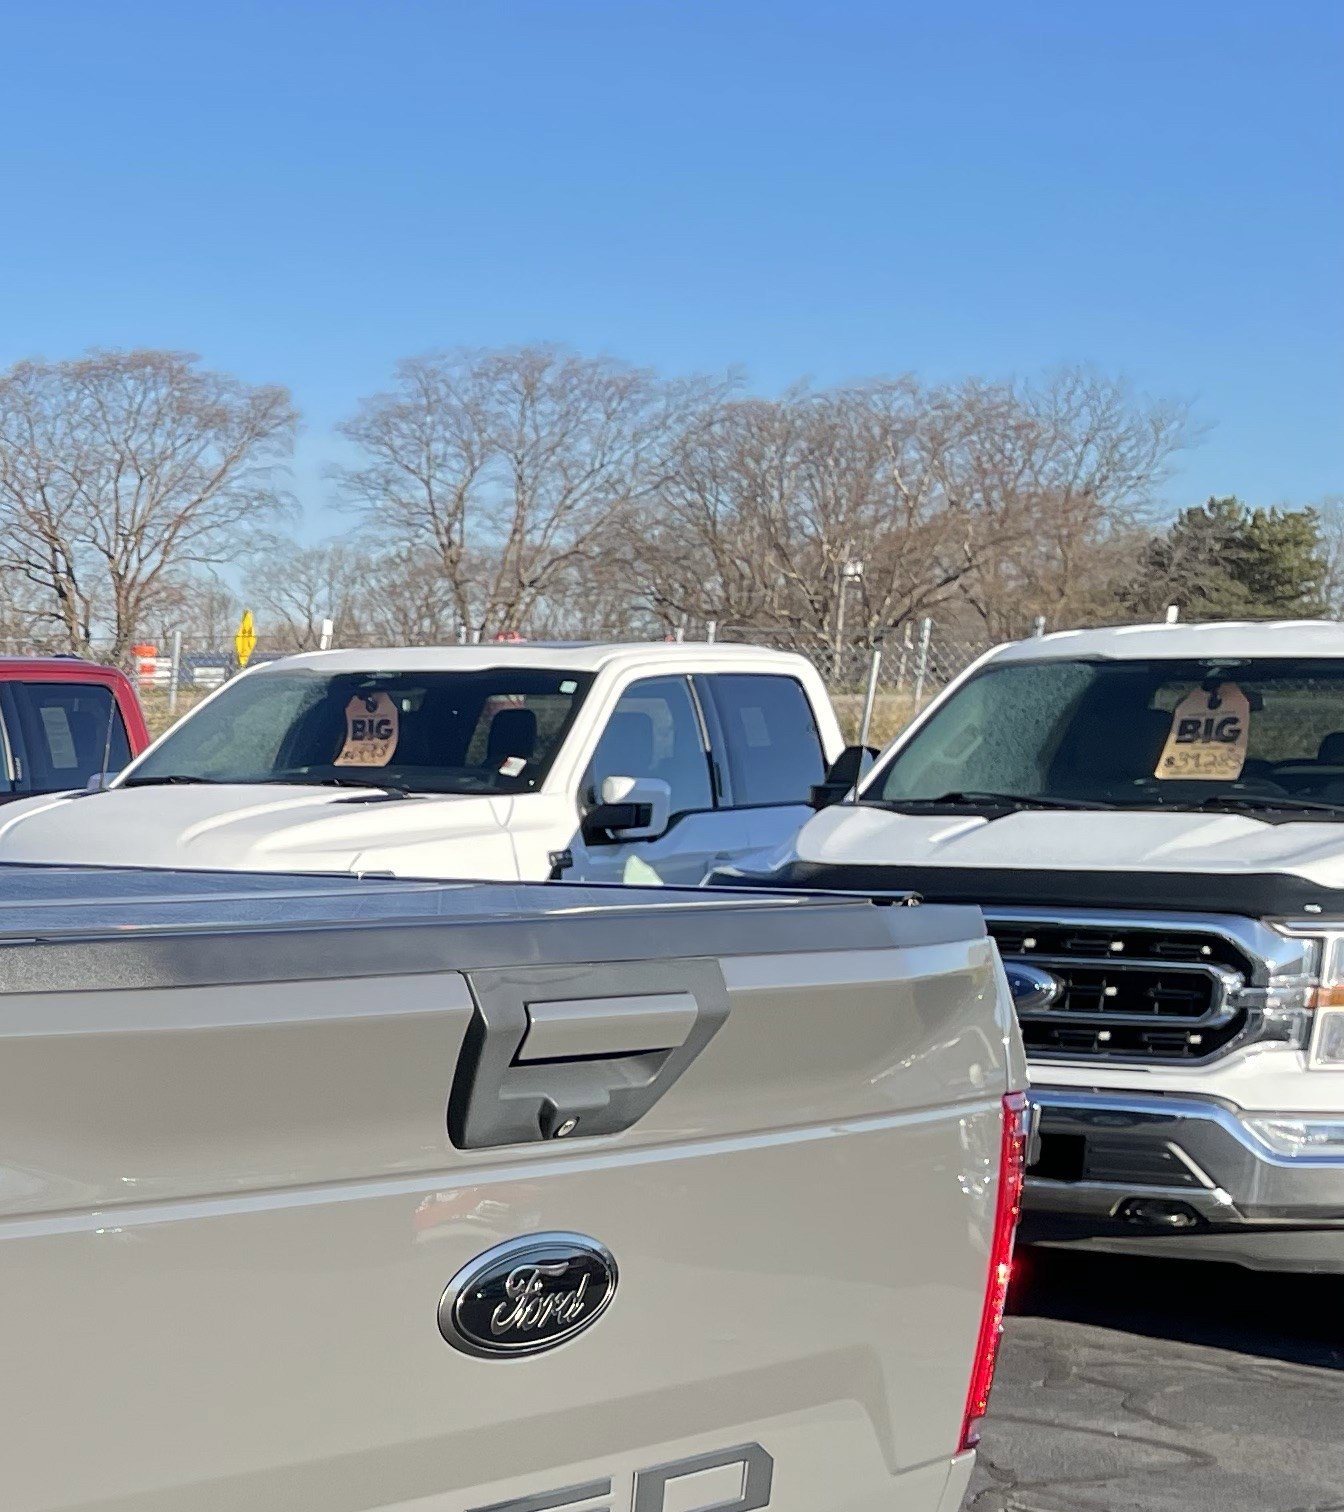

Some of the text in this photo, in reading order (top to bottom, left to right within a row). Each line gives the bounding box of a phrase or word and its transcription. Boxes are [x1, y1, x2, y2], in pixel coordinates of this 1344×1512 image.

[352, 719, 393, 741] BIG
[1175, 716, 1241, 743] BIG
[490, 1261, 590, 1335] Ford
